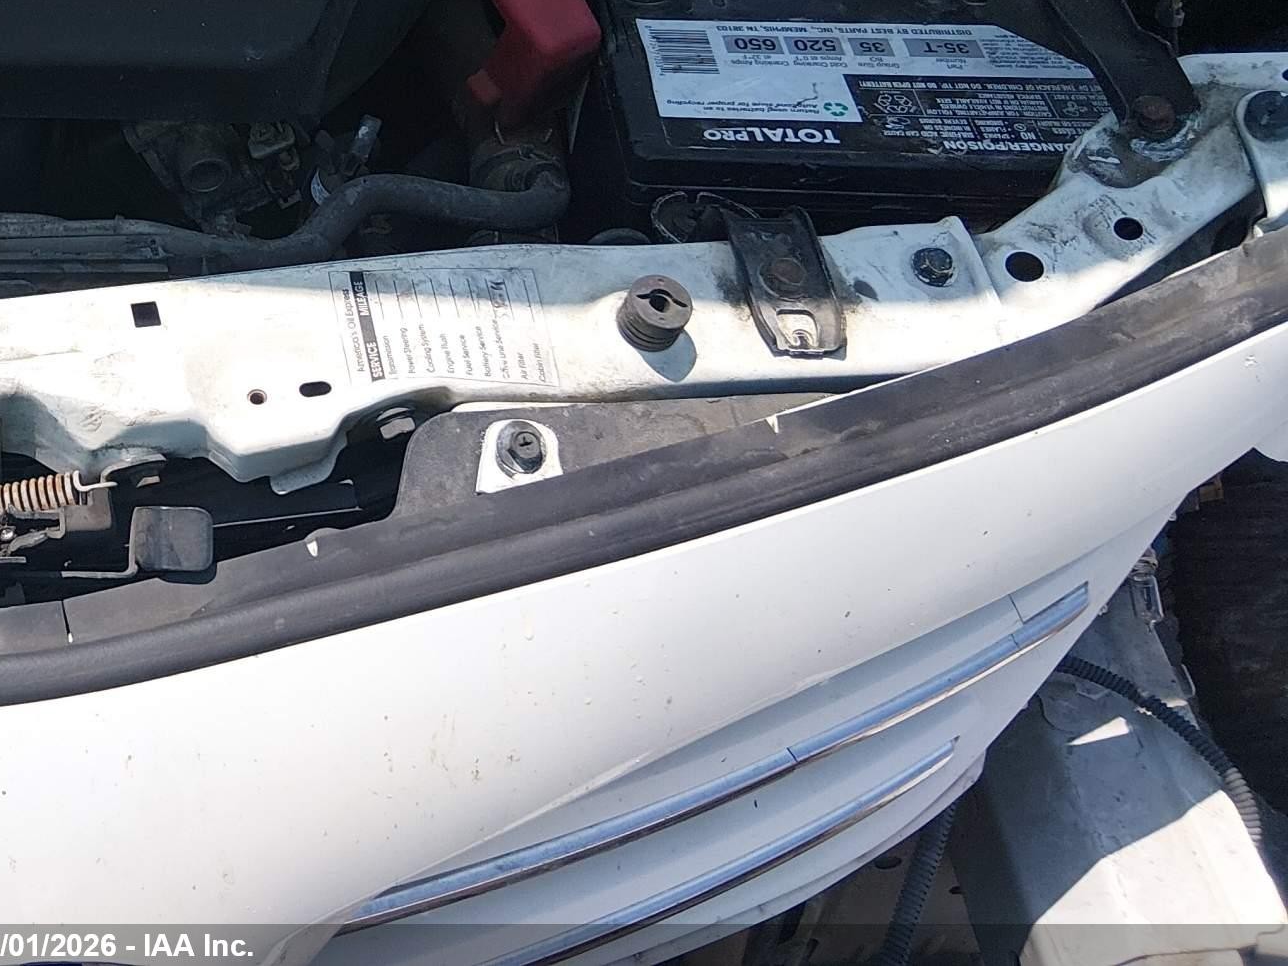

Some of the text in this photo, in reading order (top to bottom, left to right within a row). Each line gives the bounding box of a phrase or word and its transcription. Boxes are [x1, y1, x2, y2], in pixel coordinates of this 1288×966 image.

[715, 24, 745, 33] 38103
[744, 25, 760, 33] TN
[760, 25, 809, 34] MEMPHIS,
[834, 26, 869, 35] PARTS,
[870, 27, 894, 35] BEST
[896, 27, 910, 35] BY
[910, 28, 973, 36] DISTRIBUTED
[734, 38, 778, 52] 650
[793, 38, 837, 52] 520
[860, 41, 886, 54] 35
[923, 41, 970, 54] 35-T
[730, 58, 790, 67] Cranking Amps
[793, 59, 849, 68] Cold Cranking
[820, 54, 843, 62] Amps
[934, 56, 967, 64] Number
[857, 60, 900, 69] Group Size
[666, 98, 706, 107] recycling
[706, 99, 735, 107] proper
[736, 101, 750, 109] for
[726, 105, 766, 114] batteries
[790, 107, 821, 115] Return
[703, 126, 841, 144] TOTALPRO
[1019, 131, 1037, 141] NO
[942, 140, 1074, 152] DANGER/POISON
[353, 281, 370, 316] MILEAGE
[341, 289, 366, 372] America's Oil Express
[491, 319, 503, 345] Service
[399, 328, 417, 375] Power Steering
[417, 325, 436, 374] Cooling System
[439, 333, 456, 375] Engine Flush
[475, 326, 492, 378] Battery Service
[365, 341, 384, 379] SERVICE
[382, 335, 398, 376] Transmission
[458, 335, 473, 377] Fuel Service
[516, 353, 529, 381] Air Filter
[532, 343, 546, 383] Cabin Filter
